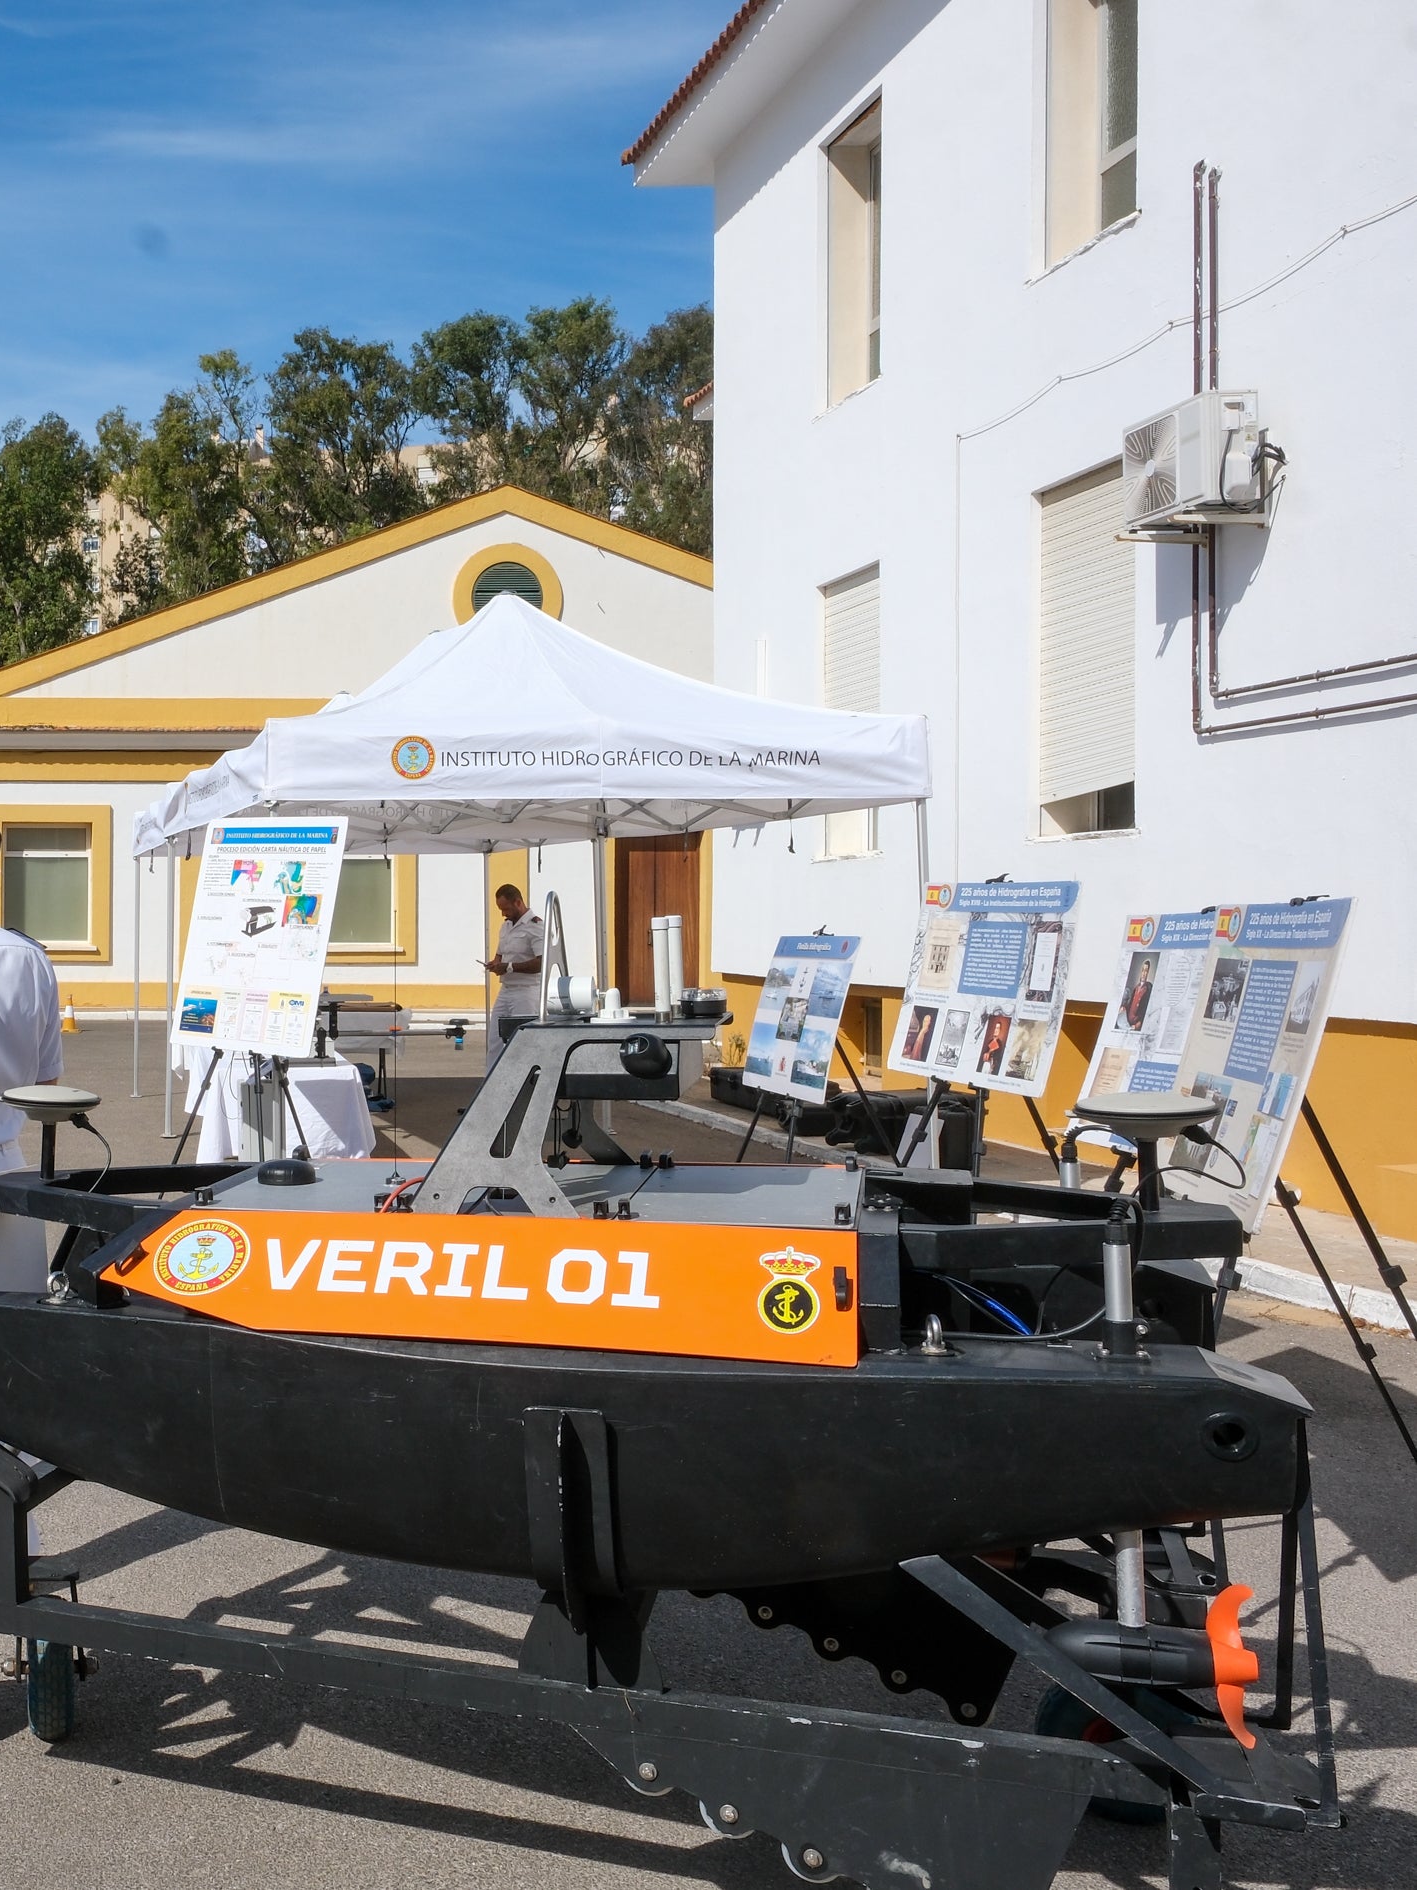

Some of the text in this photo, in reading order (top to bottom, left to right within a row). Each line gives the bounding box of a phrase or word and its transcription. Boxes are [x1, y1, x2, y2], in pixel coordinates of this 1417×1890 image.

[441, 748, 821, 770] INSTITUTO HIDROGRÁFICO DE LA MARINA
[960, 887, 972, 896] 225
[973, 887, 988, 896] años
[989, 887, 997, 896] de
[998, 886, 1030, 899] Hidrografía
[1039, 886, 1061, 899] España
[1164, 920, 1176, 930] 225
[1176, 920, 1190, 930] años
[1190, 920, 1198, 929] de
[1250, 909, 1331, 928] 225 años de Hidrografía en España
[1161, 934, 1172, 944] Siglo
[228, 1230, 239, 1240] DE
[234, 1240, 244, 1250] LA
[158, 1244, 172, 1280] INSTITUTO
[218, 1252, 244, 1282] MARINA
[266, 1238, 660, 1309] VERIL 01
